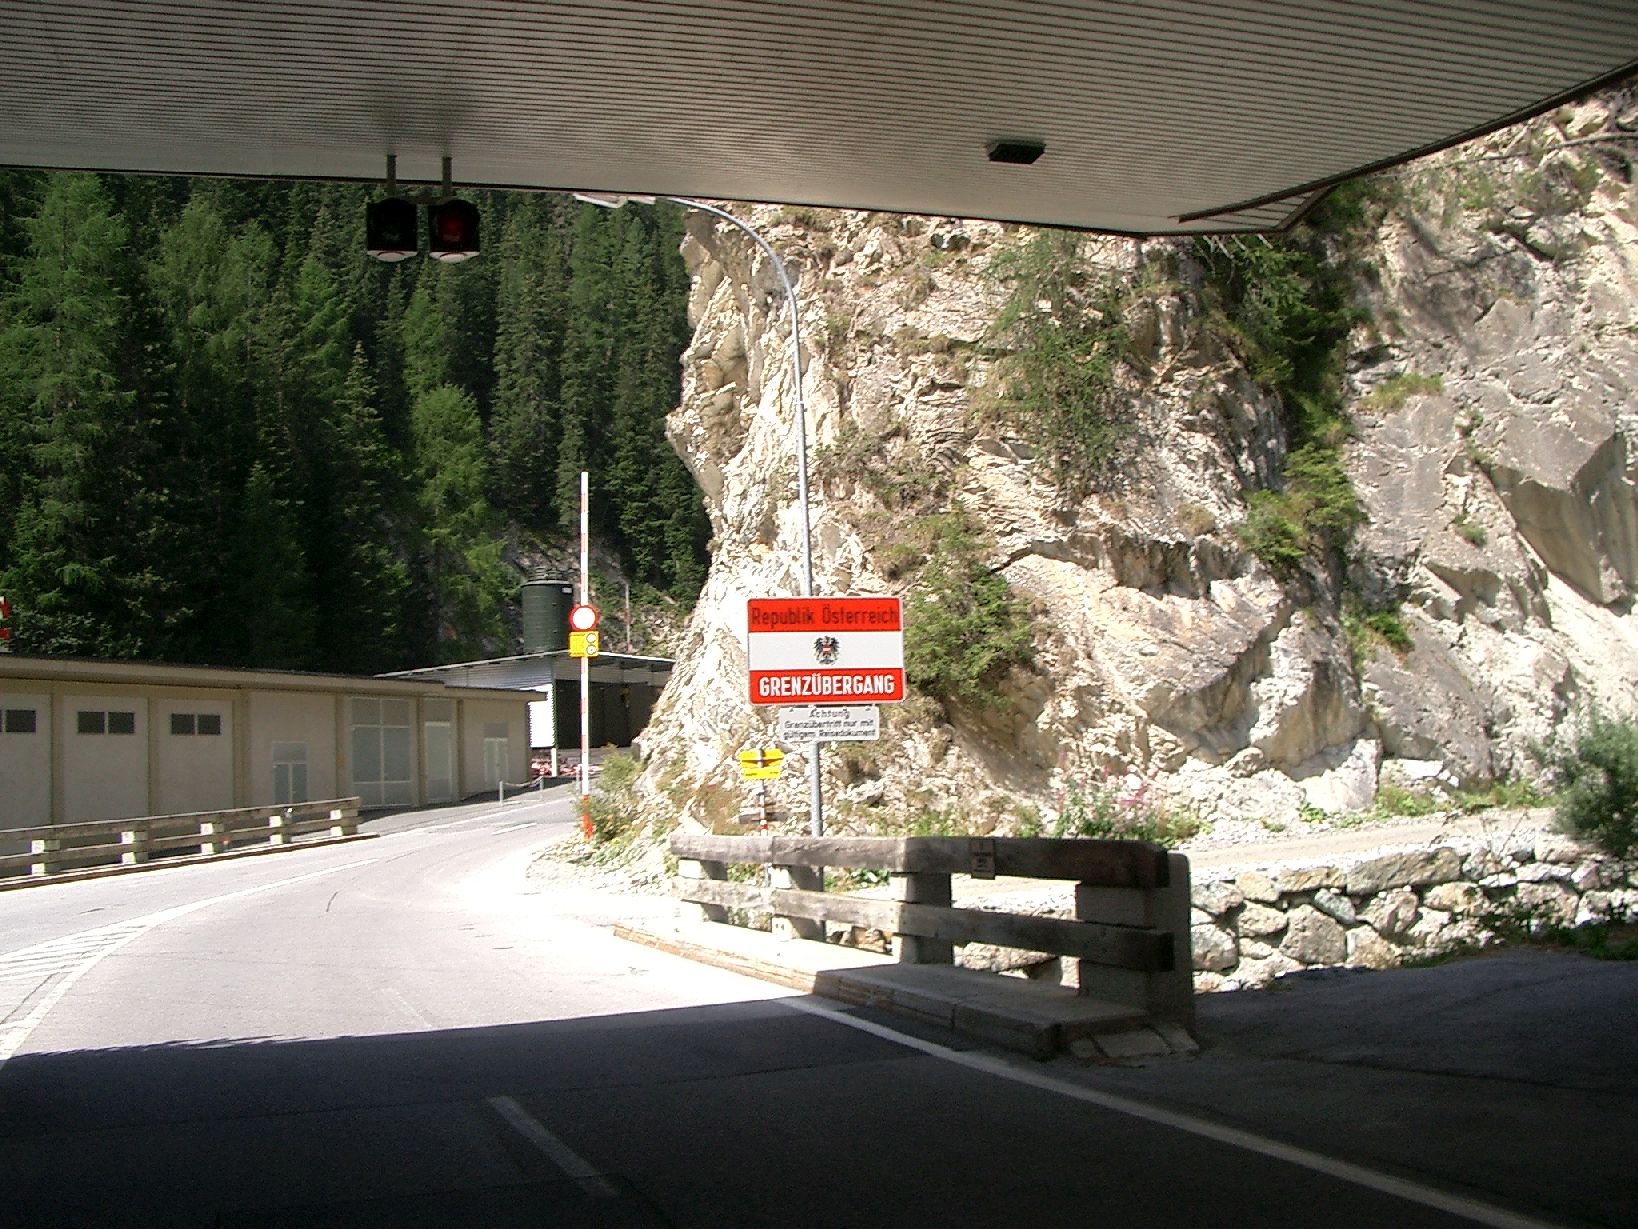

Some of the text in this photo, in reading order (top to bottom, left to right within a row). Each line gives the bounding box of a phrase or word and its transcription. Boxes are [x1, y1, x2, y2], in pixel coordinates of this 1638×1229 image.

[752, 604, 897, 628] Republik Österreich
[759, 673, 895, 697] GRENZÜBERGANG
[809, 708, 850, 719] Achtung
